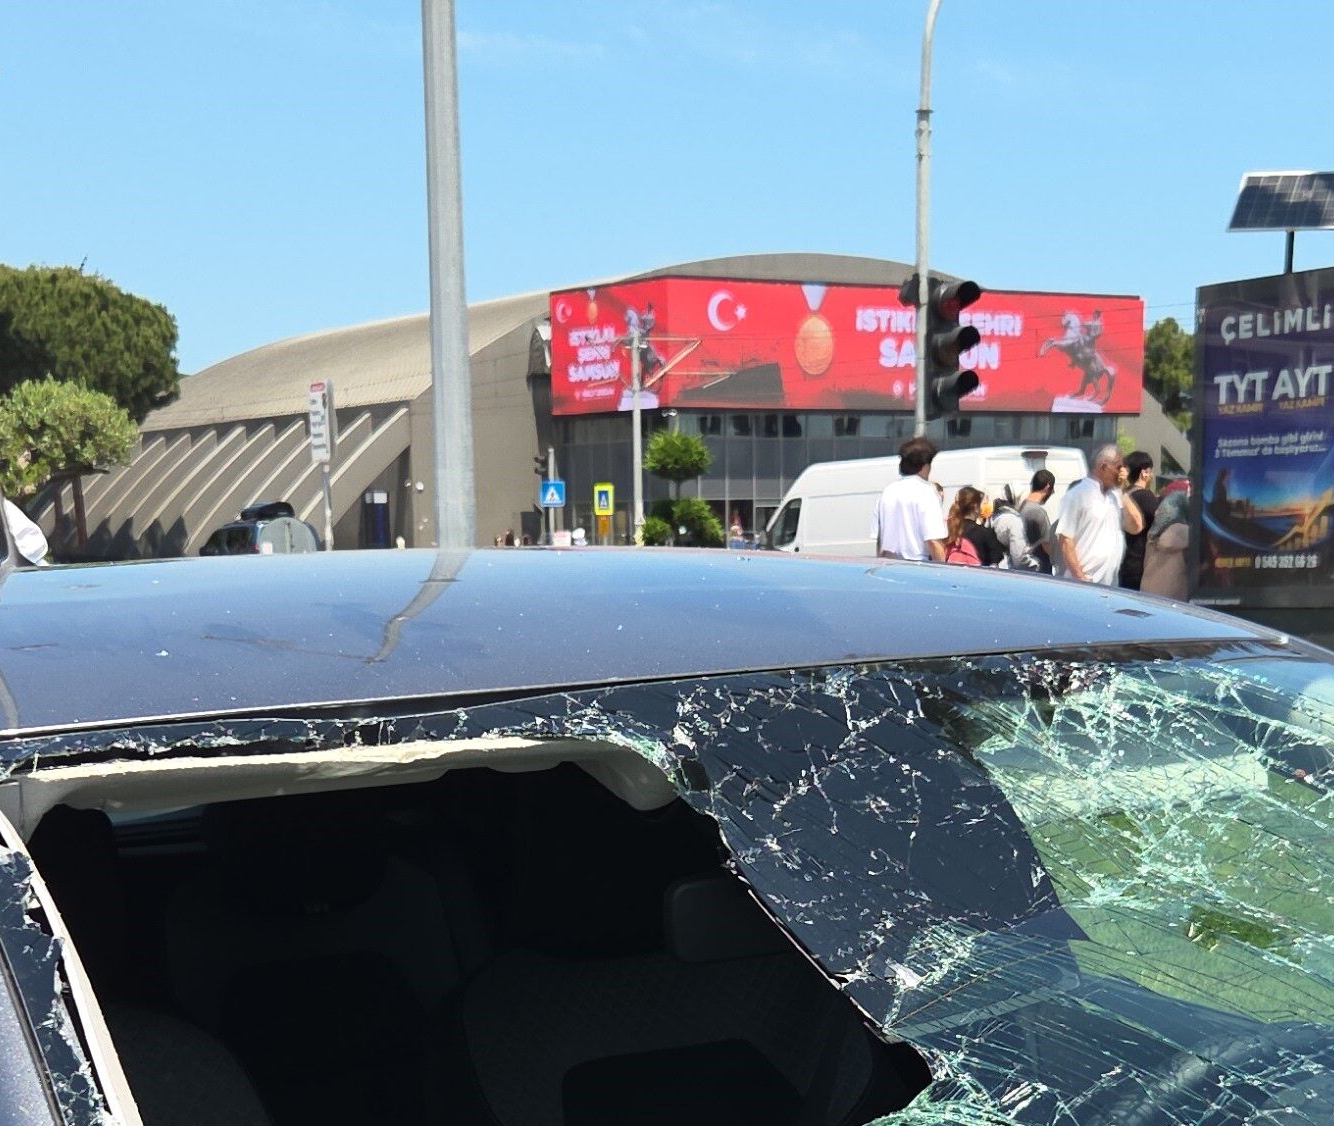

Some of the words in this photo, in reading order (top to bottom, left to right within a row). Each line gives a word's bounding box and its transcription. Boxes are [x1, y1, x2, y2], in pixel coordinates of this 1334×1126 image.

[1220, 303, 1332, 346] ÇELİMLİ
[1213, 370, 1269, 405] TYT
[1271, 364, 1333, 401] AYT
